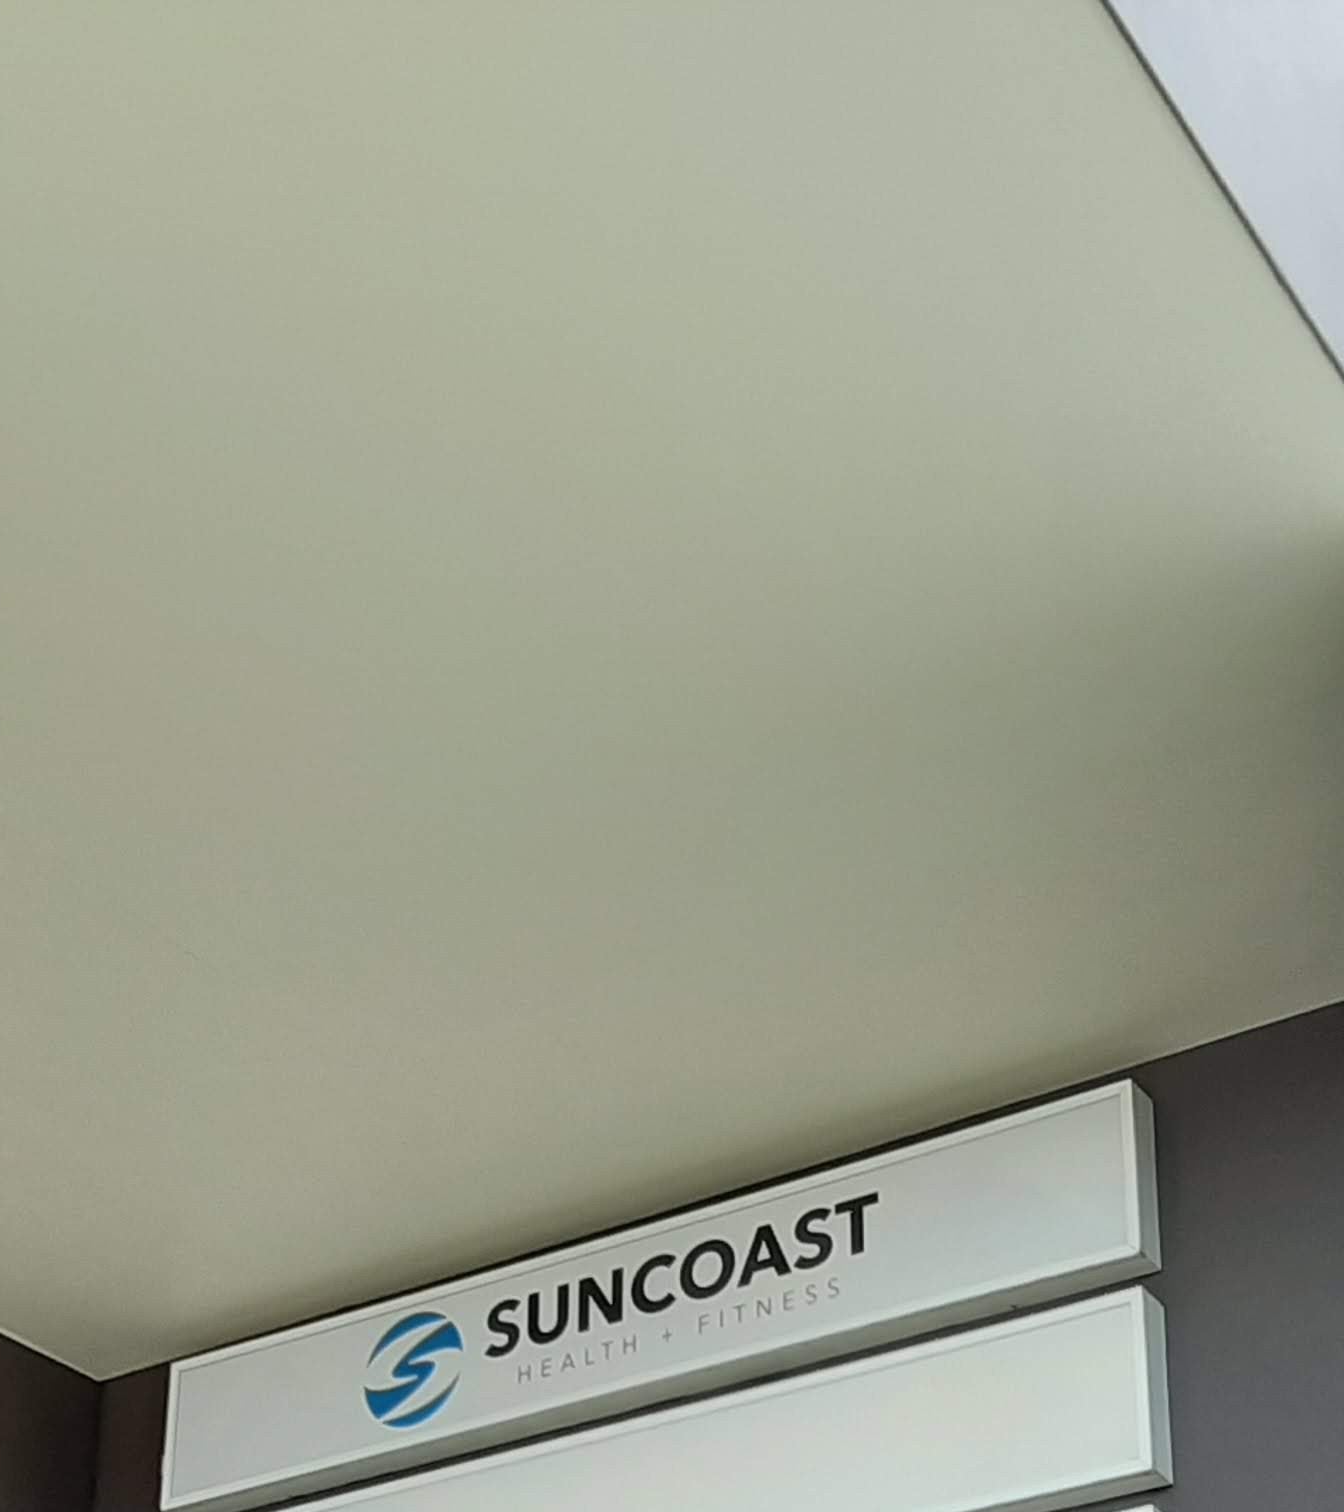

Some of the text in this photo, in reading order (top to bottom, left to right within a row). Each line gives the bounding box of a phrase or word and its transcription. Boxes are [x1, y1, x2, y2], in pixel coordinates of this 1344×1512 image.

[484, 1192, 879, 1359] SUNCOAST
[517, 1335, 639, 1385] HEALTH
[697, 1276, 843, 1336] FITNESS
